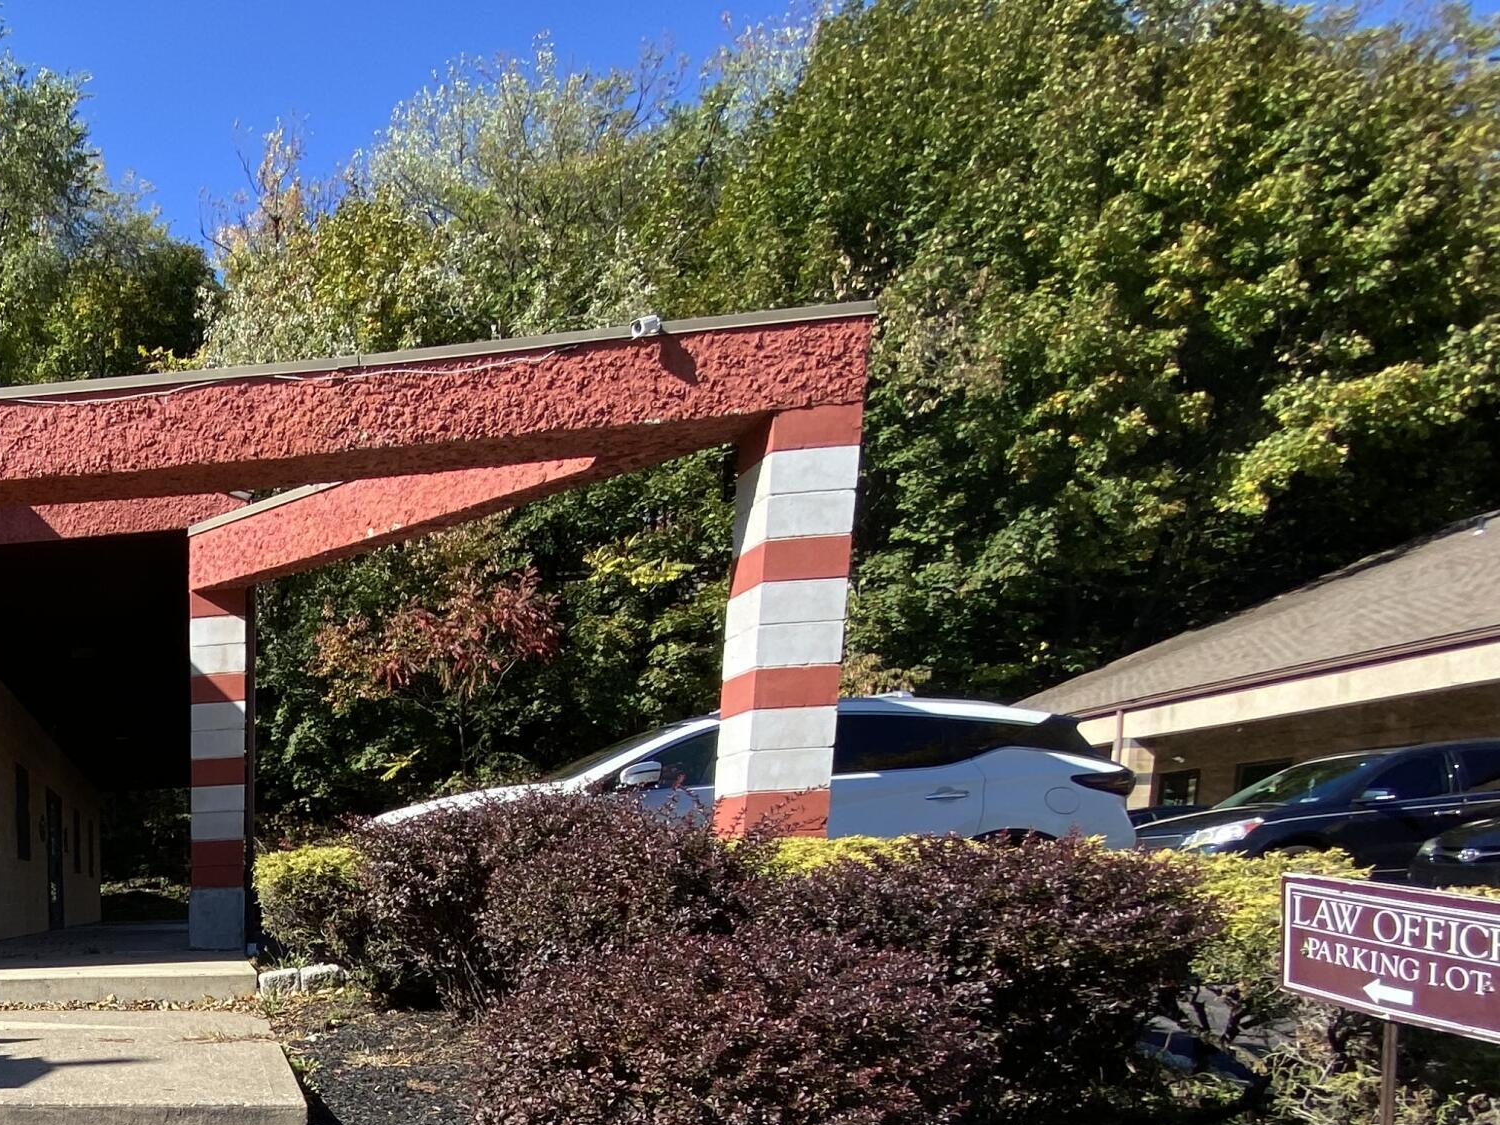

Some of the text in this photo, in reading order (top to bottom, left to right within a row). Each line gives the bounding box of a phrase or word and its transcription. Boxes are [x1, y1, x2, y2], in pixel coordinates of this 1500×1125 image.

[1292, 894, 1363, 935] LAW
[1306, 936, 1493, 995] PARKING LOT
